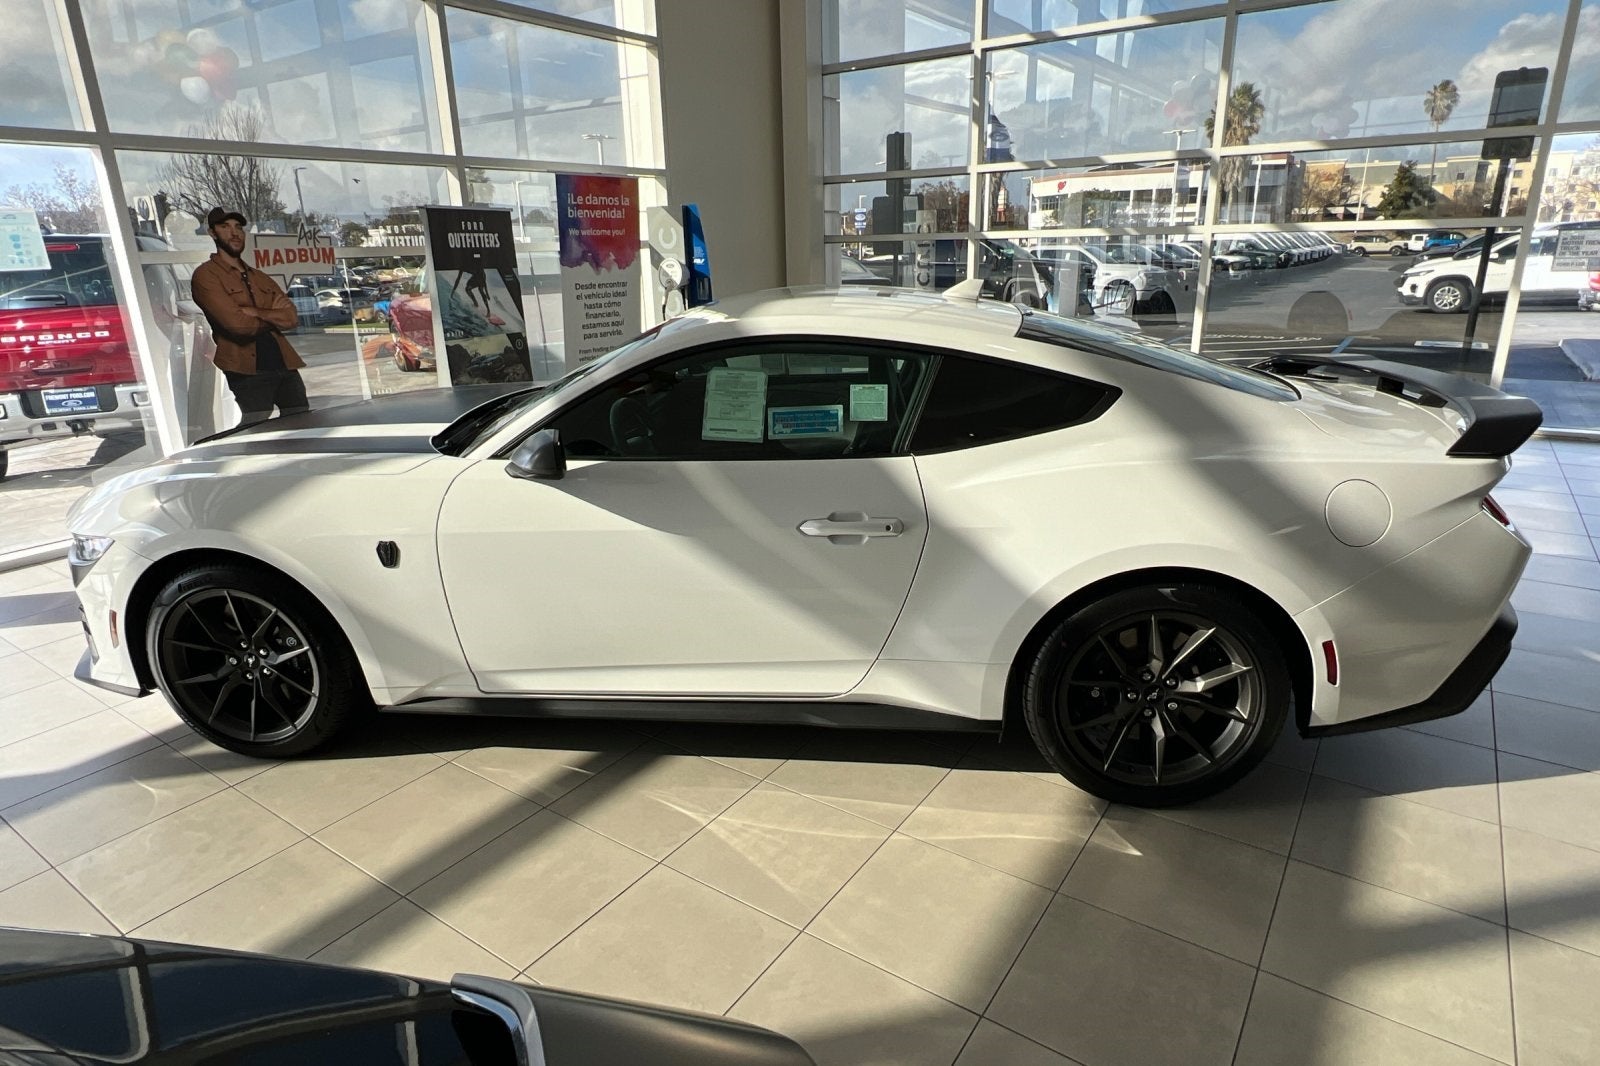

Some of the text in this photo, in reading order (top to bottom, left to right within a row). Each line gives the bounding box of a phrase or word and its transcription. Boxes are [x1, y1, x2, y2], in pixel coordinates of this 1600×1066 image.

[585, 193, 620, 206] damos
[621, 193, 630, 206] la
[567, 206, 625, 219] bienvenida!
[461, 221, 484, 231] FORD
[568, 228, 626, 237] We welcome you!
[447, 232, 500, 248] OUTFITTERS
[253, 246, 336, 269] MADBUM
[575, 281, 628, 290] Desde encontrar
[584, 291, 611, 300] vehículo
[612, 290, 628, 298] ideal
[583, 300, 622, 310] hasta cómo
[582, 321, 610, 330] estamos
[0, 331, 110, 343] BRONCO
[583, 332, 598, 341] para
